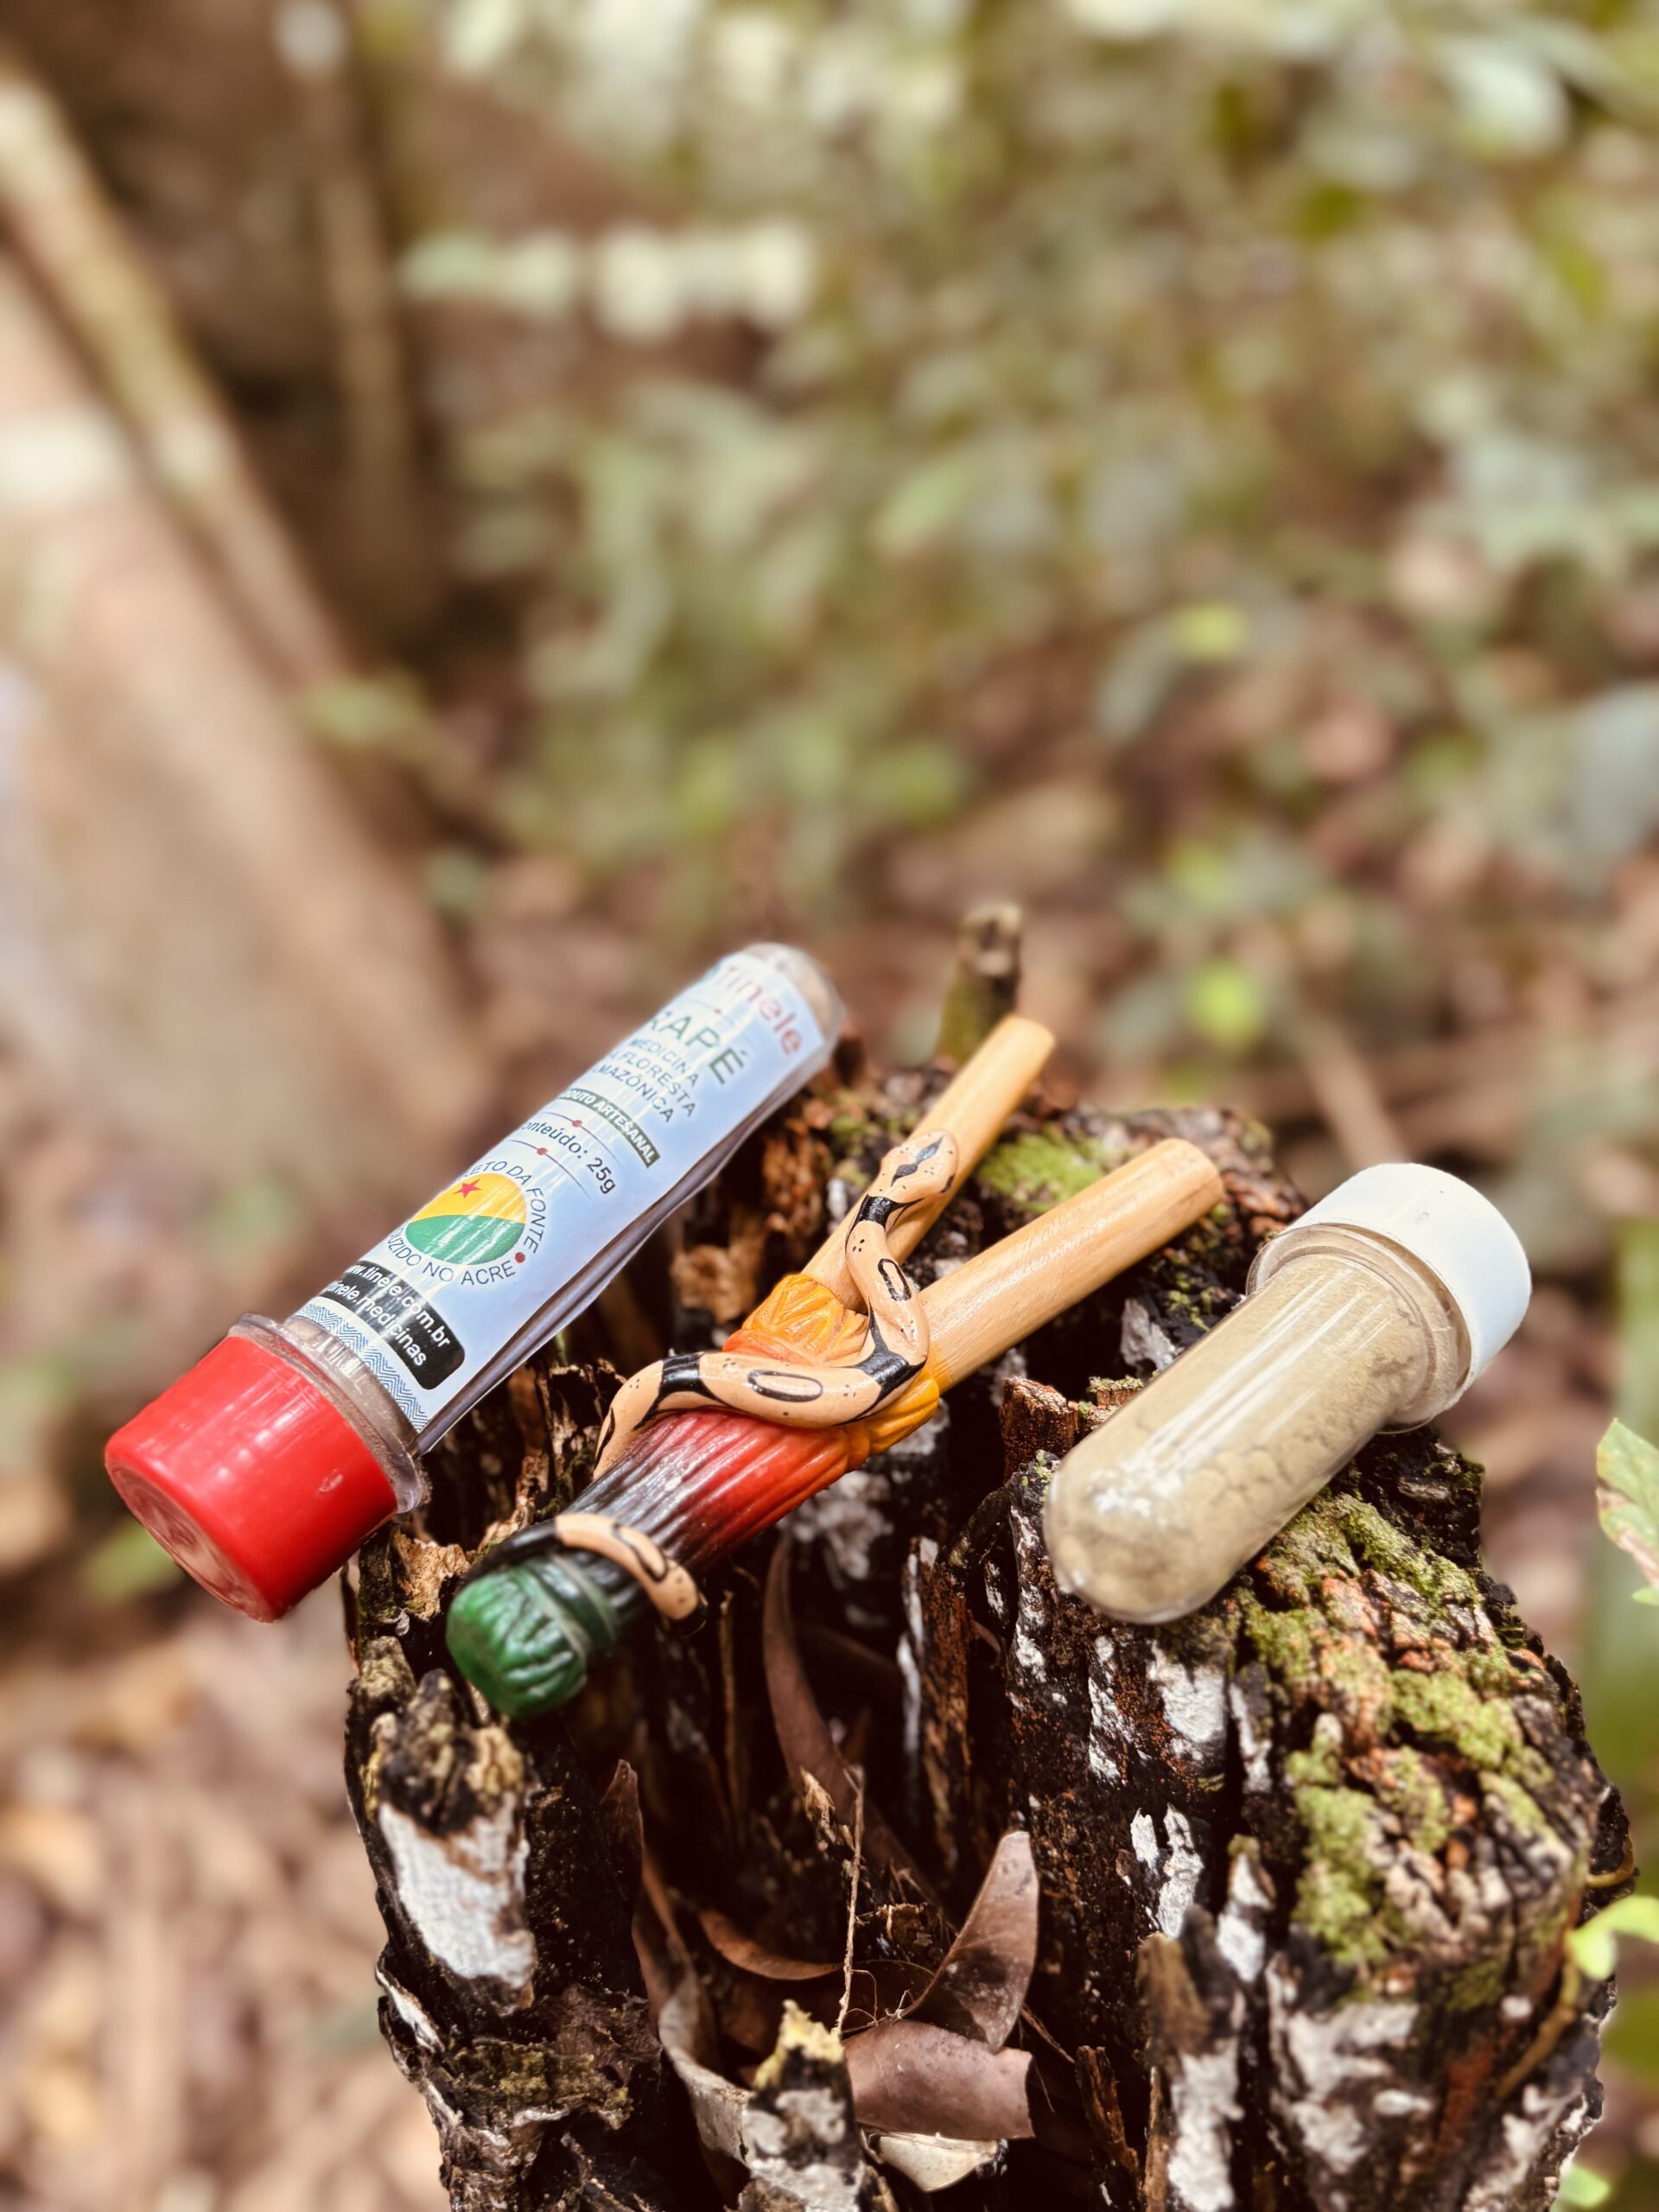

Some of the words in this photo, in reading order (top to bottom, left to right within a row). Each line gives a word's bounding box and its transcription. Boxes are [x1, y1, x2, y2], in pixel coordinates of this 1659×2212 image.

[591, 1063, 675, 1123] MAZÔNICA
[616, 1050, 697, 1118] FLORESTA
[593, 1101, 656, 1164] ARTESANAL
[585, 1156, 617, 1195] 25g
[505, 1165, 533, 1186] DA
[523, 1186, 548, 1255] FONTE
[422, 1261, 454, 1282] NO
[461, 1260, 517, 1286] ACRE
[343, 1263, 451, 1349] w.tinele.com.br
